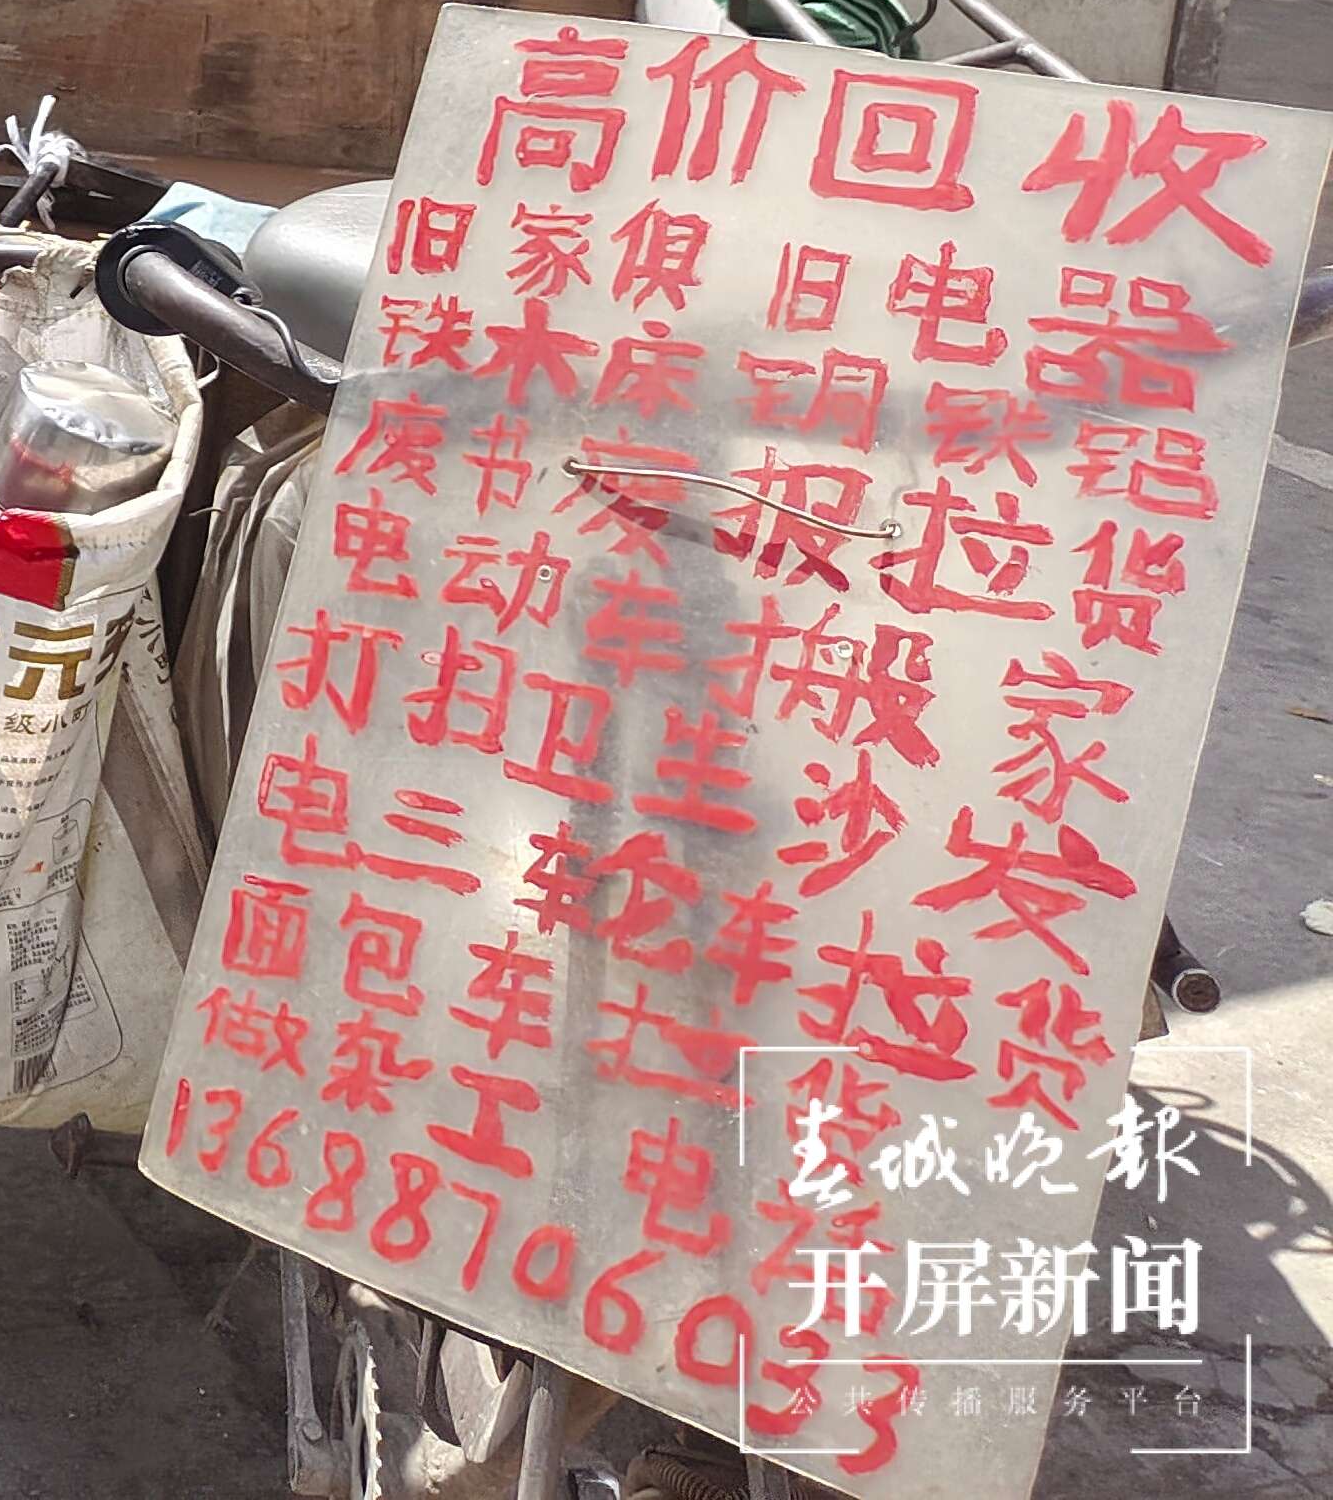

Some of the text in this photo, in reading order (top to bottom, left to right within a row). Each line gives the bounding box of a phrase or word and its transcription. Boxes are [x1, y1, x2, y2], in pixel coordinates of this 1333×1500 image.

[477, 25, 1274, 268] 高价回收
[164, 1077, 922, 1475] 13688706033
